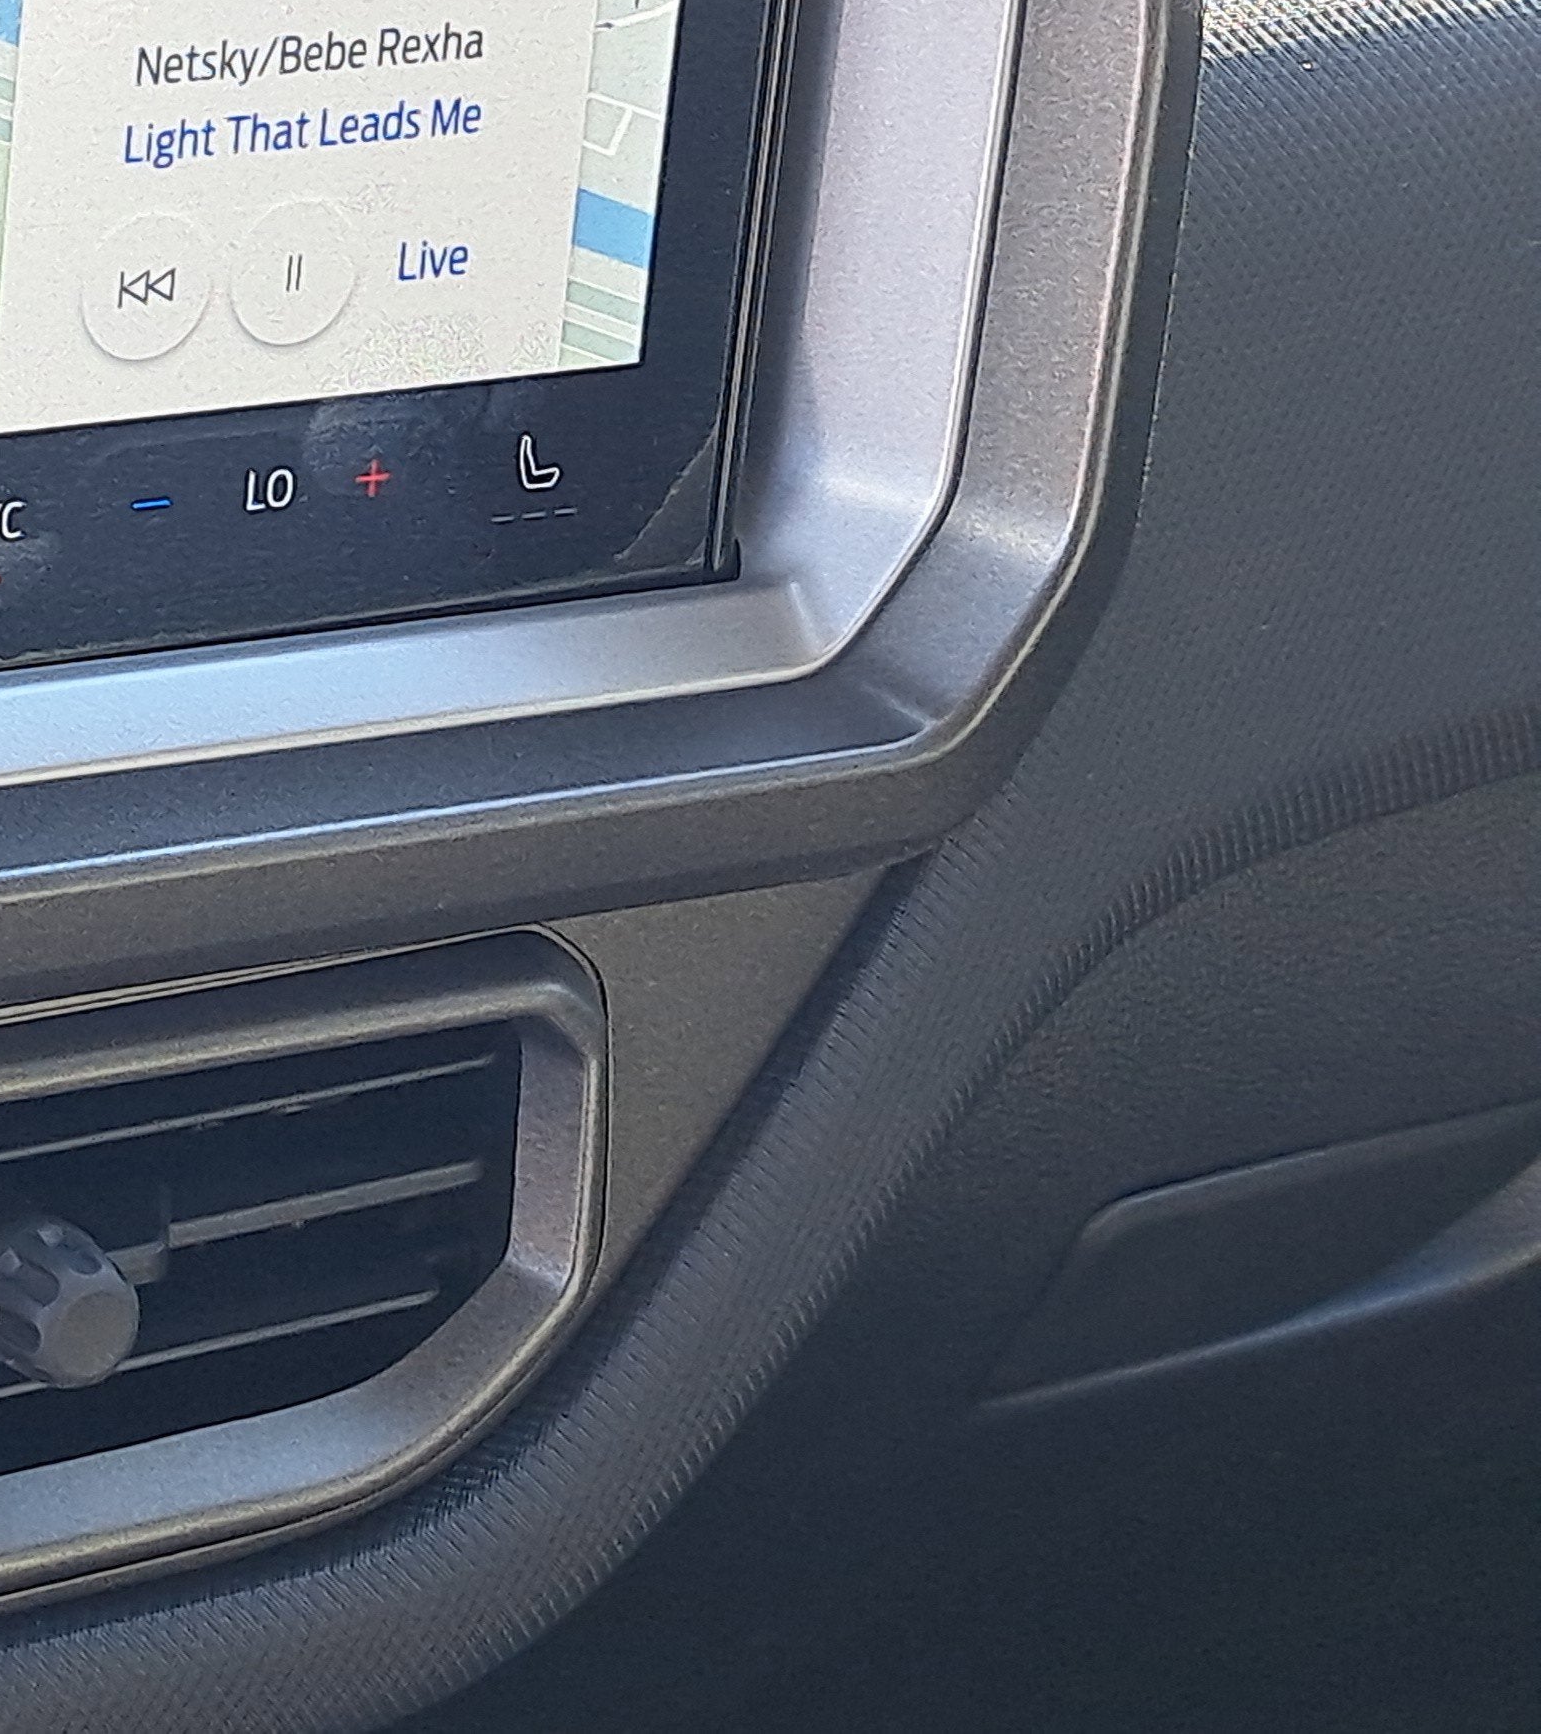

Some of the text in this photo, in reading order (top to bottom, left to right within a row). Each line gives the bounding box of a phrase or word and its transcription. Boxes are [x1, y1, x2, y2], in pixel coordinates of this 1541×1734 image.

[135, 23, 484, 84] Netsky/Bebe Rexha
[124, 97, 482, 170] Light That Leads Me
[397, 239, 469, 281] Live
[243, 468, 295, 512] LO
